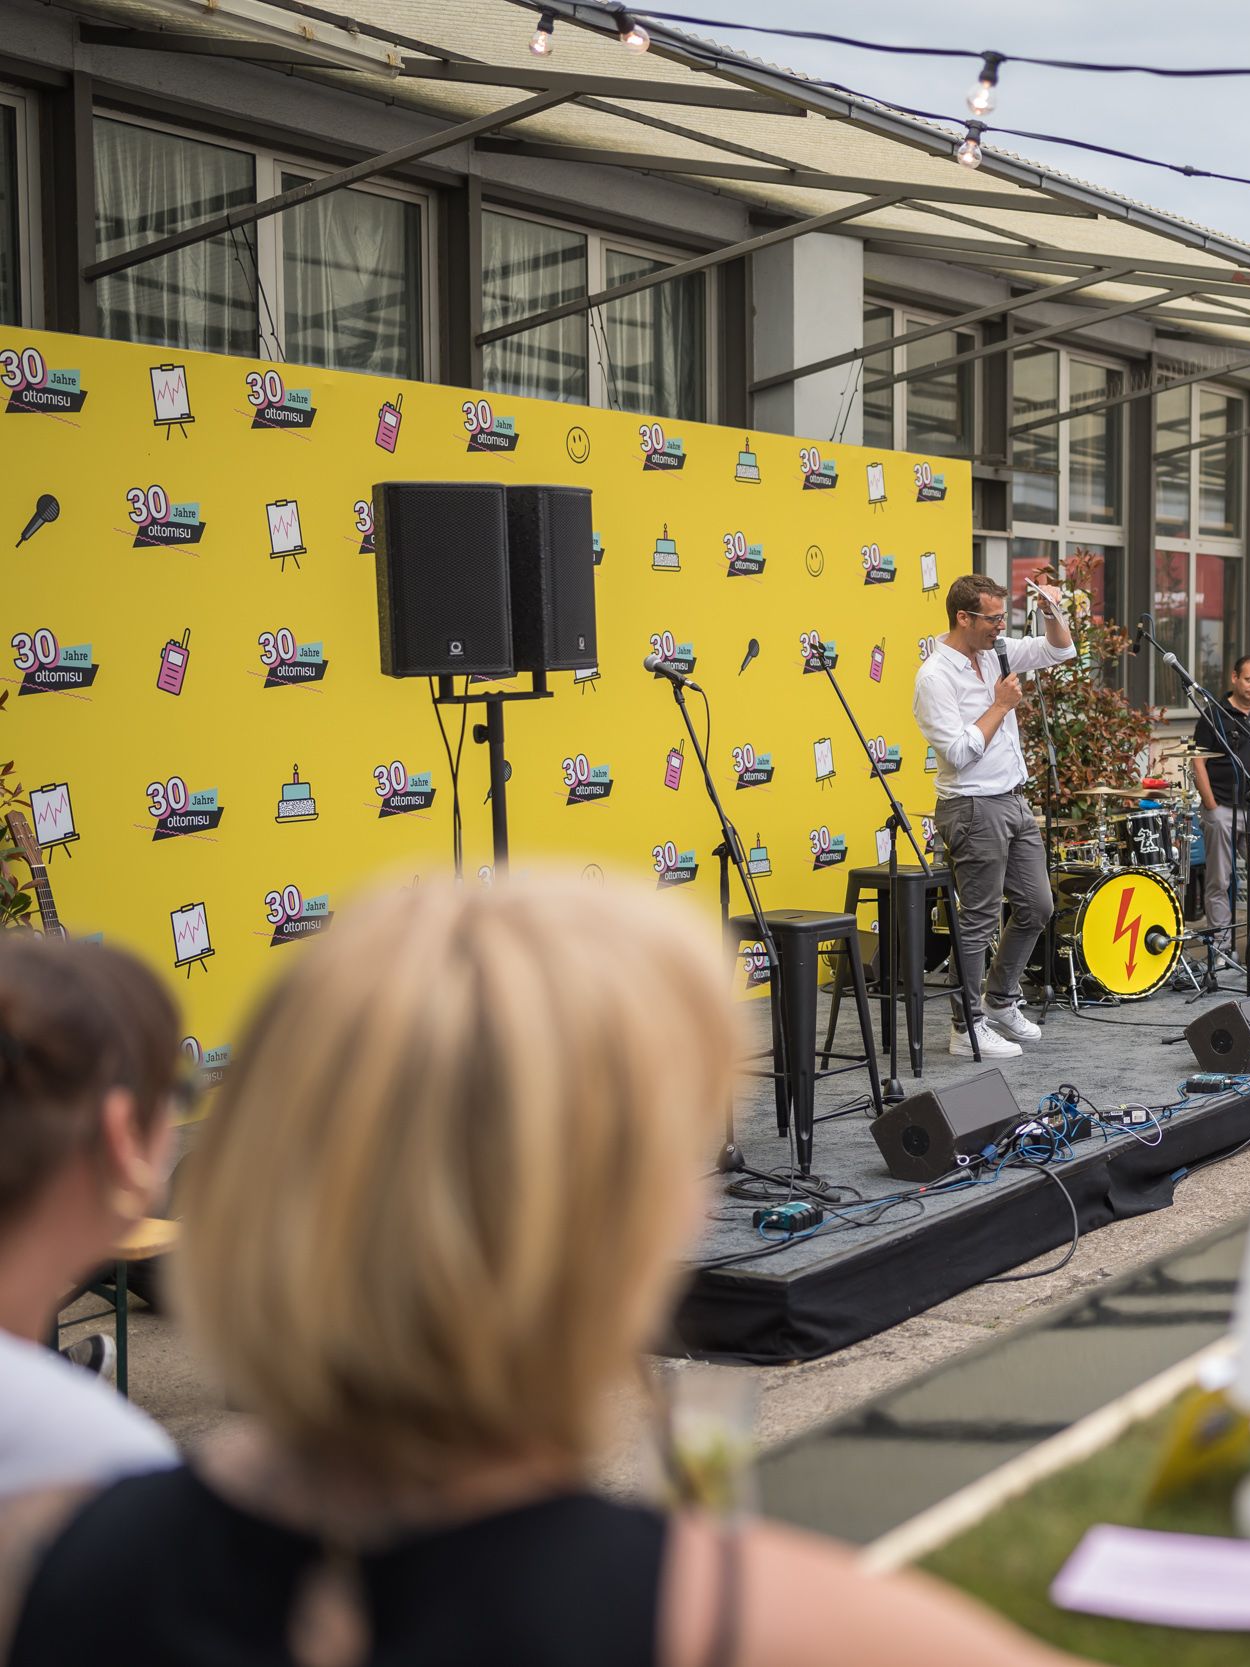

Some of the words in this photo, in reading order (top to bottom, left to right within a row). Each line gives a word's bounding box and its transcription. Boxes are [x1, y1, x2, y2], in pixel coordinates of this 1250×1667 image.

[0, 347, 45, 388] 30
[50, 373, 77, 386] Jahre
[22, 389, 71, 407] ottomisu
[245, 369, 283, 406] 30
[287, 392, 308, 404] Jahre
[264, 408, 304, 423] ottomisu
[462, 399, 492, 432] 30
[495, 420, 513, 430] Jahre
[477, 433, 509, 447] ottomisu
[639, 422, 664, 452] 30
[651, 454, 678, 466] ottomisu
[799, 446, 820, 473] 30
[913, 461, 932, 487] 30
[126, 484, 168, 523] 30
[173, 507, 196, 518] Jahre
[353, 500, 375, 532] 3
[148, 525, 191, 538] ottomisu
[723, 530, 747, 559] 30
[734, 560, 759, 571] ottomisu
[861, 543, 880, 570] 30
[11, 627, 57, 671] 30
[63, 650, 88, 661] Jahre
[258, 627, 295, 665] 30
[299, 647, 320, 657] Jahre
[649, 630, 675, 660] 30
[35, 670, 83, 682] ottomisu
[277, 665, 316, 676] ottomisu
[562, 753, 589, 787] 30
[591, 769, 608, 778] Jahre
[732, 742, 754, 773] 30
[373, 760, 407, 797] 30
[410, 777, 429, 787] Jahre
[743, 772, 768, 781] ottomisu
[146, 775, 187, 817] 30
[191, 795, 215, 806] Jahre
[390, 795, 425, 806] ottomisu
[575, 785, 605, 796] ottomisu
[167, 815, 210, 828] ottomisu
[809, 825, 830, 855] 30
[652, 840, 677, 873] 30
[664, 870, 691, 880] ottomisu
[264, 884, 301, 924] 30
[305, 901, 326, 912] Jahre
[283, 919, 321, 933] ottomisu
[205, 1052, 228, 1063] Jahre
